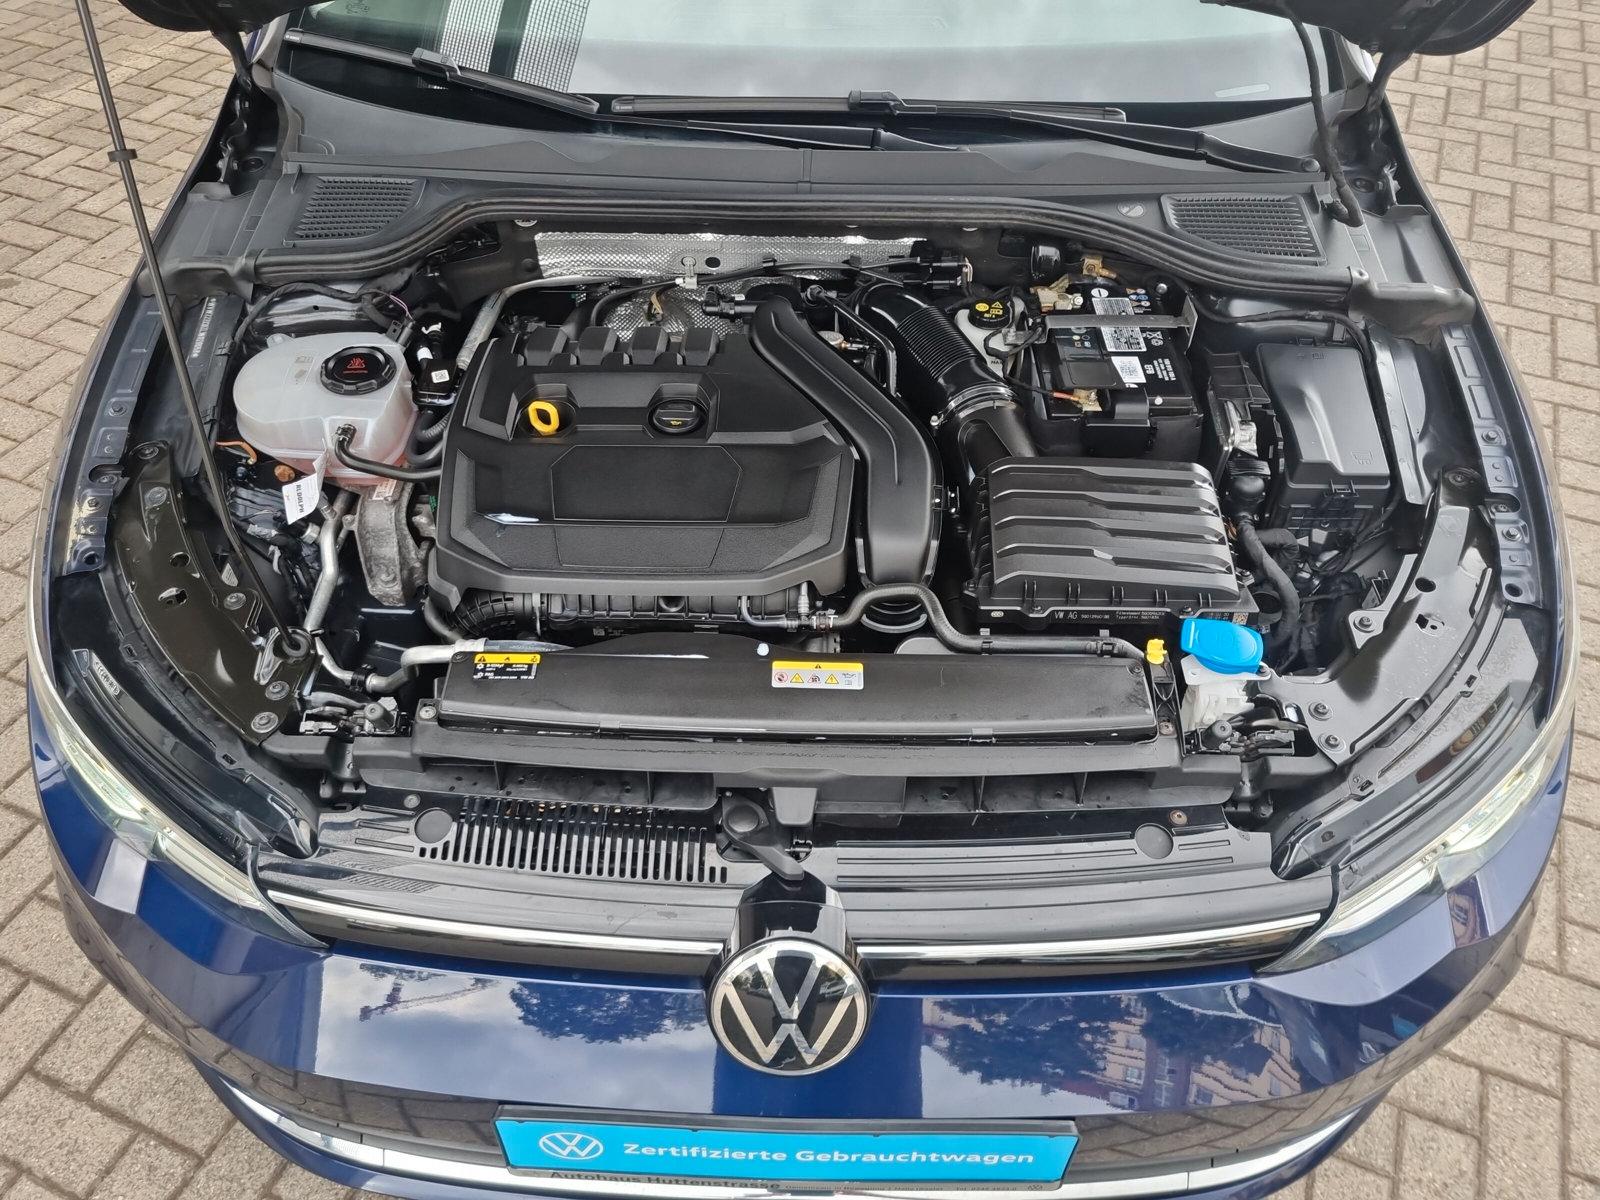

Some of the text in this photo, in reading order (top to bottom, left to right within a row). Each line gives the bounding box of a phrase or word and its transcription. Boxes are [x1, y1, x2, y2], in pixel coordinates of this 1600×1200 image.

[1054, 611, 1064, 619] VW
[1068, 611, 1078, 620] AG
[624, 1144, 787, 1161] Zertifizierte
[796, 1150, 1034, 1165] Gebrauchtwagen
[551, 1171, 641, 1182] Autohaus
